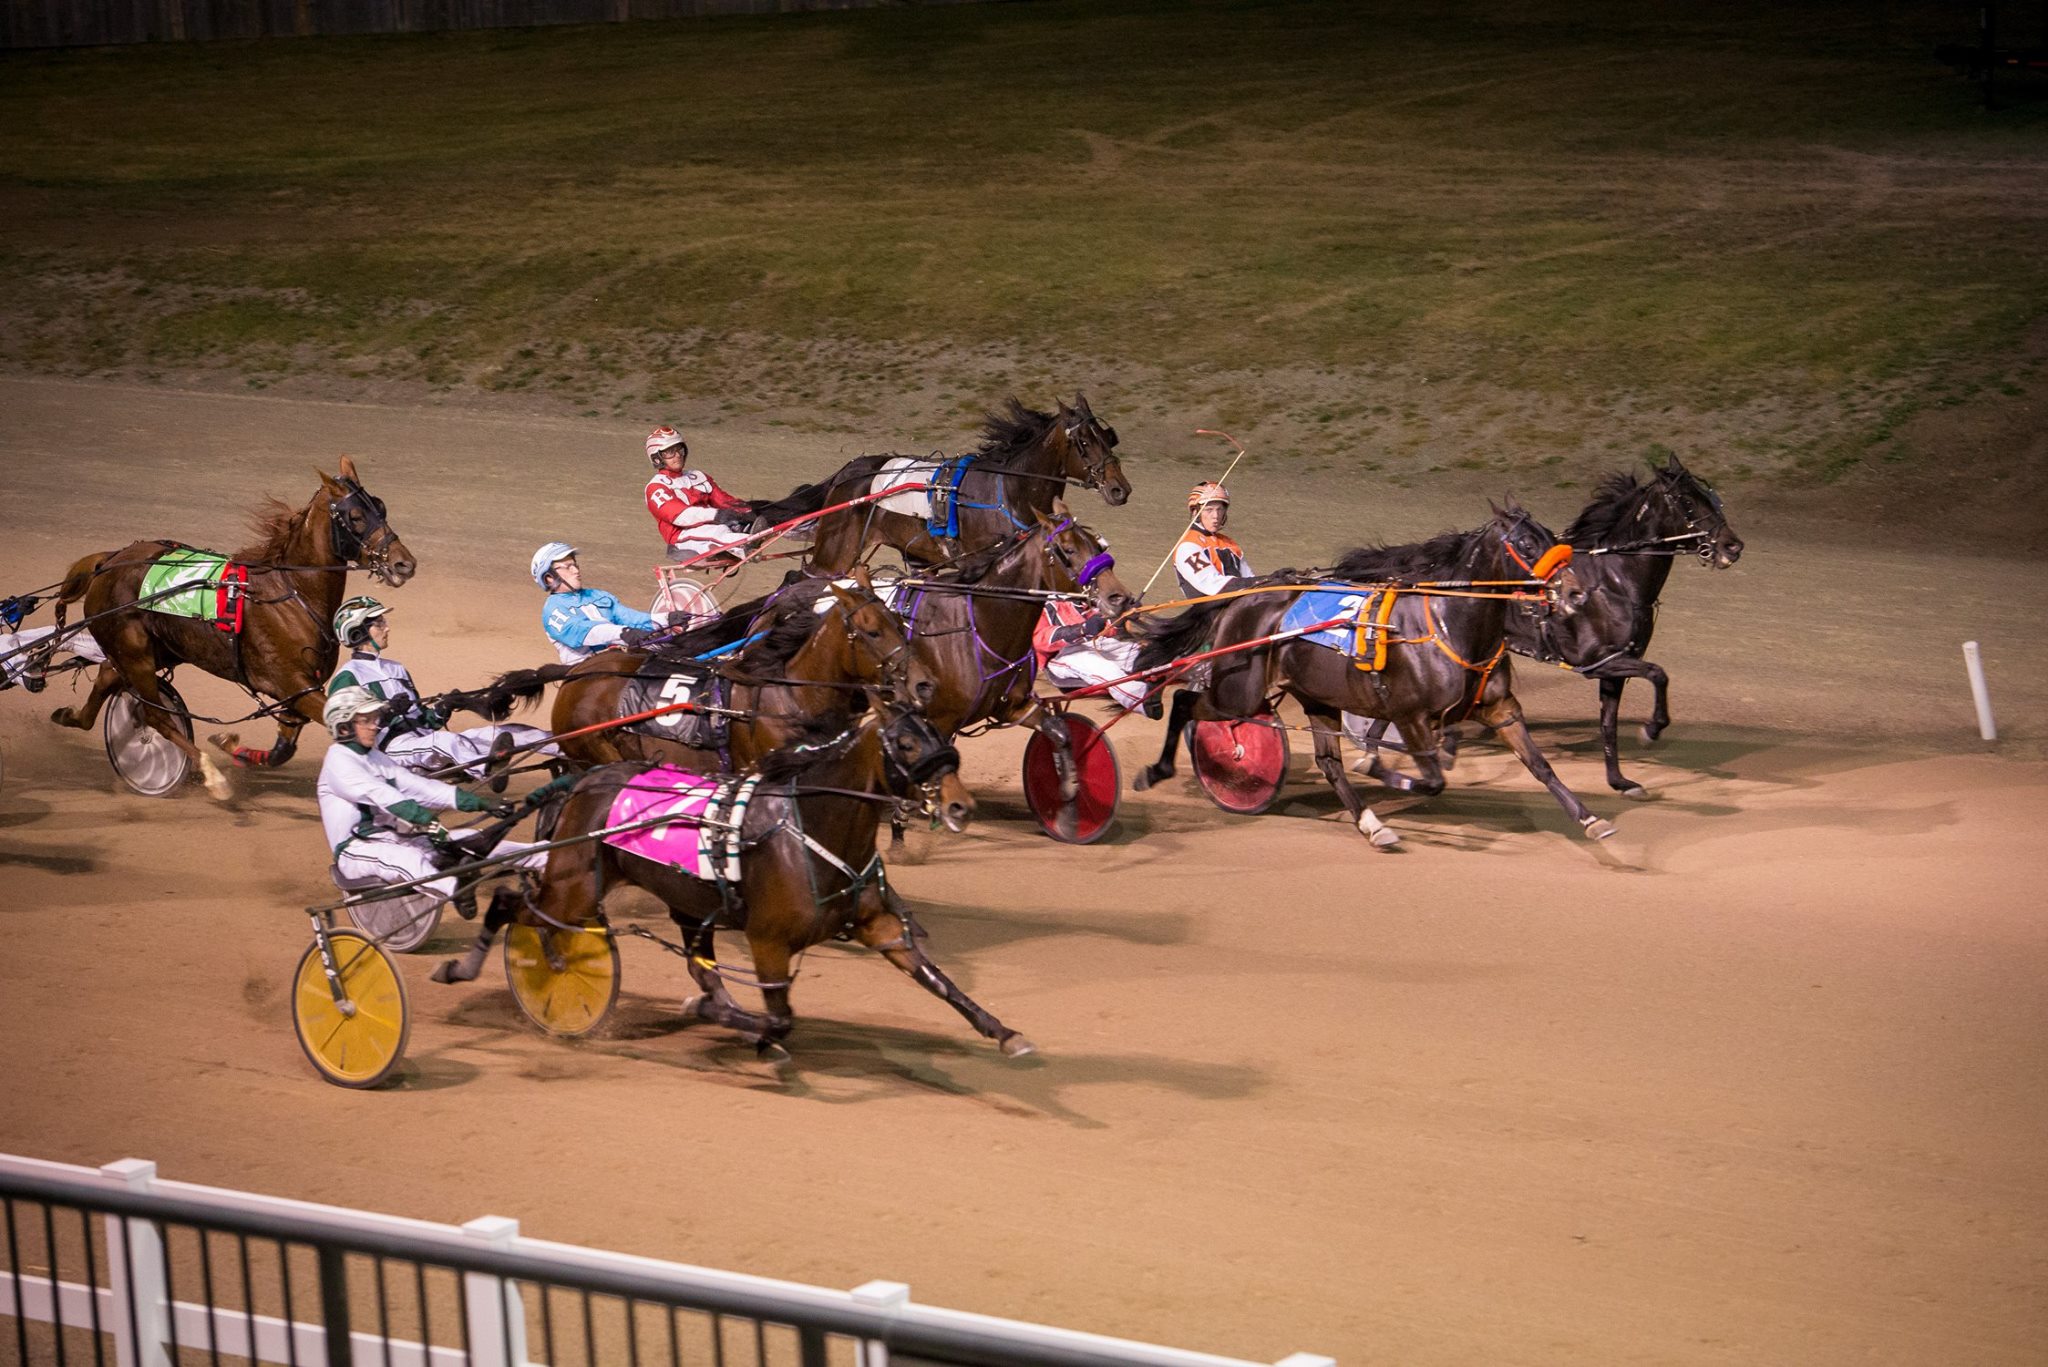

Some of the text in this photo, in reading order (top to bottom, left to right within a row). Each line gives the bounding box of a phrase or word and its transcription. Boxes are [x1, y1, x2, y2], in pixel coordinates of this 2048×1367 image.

[651, 488, 673, 509] R
[1184, 552, 1211, 574] K
[548, 608, 571, 633] H
[1323, 595, 1365, 638] 2
[655, 673, 699, 727] 5
[651, 782, 714, 841] 7
